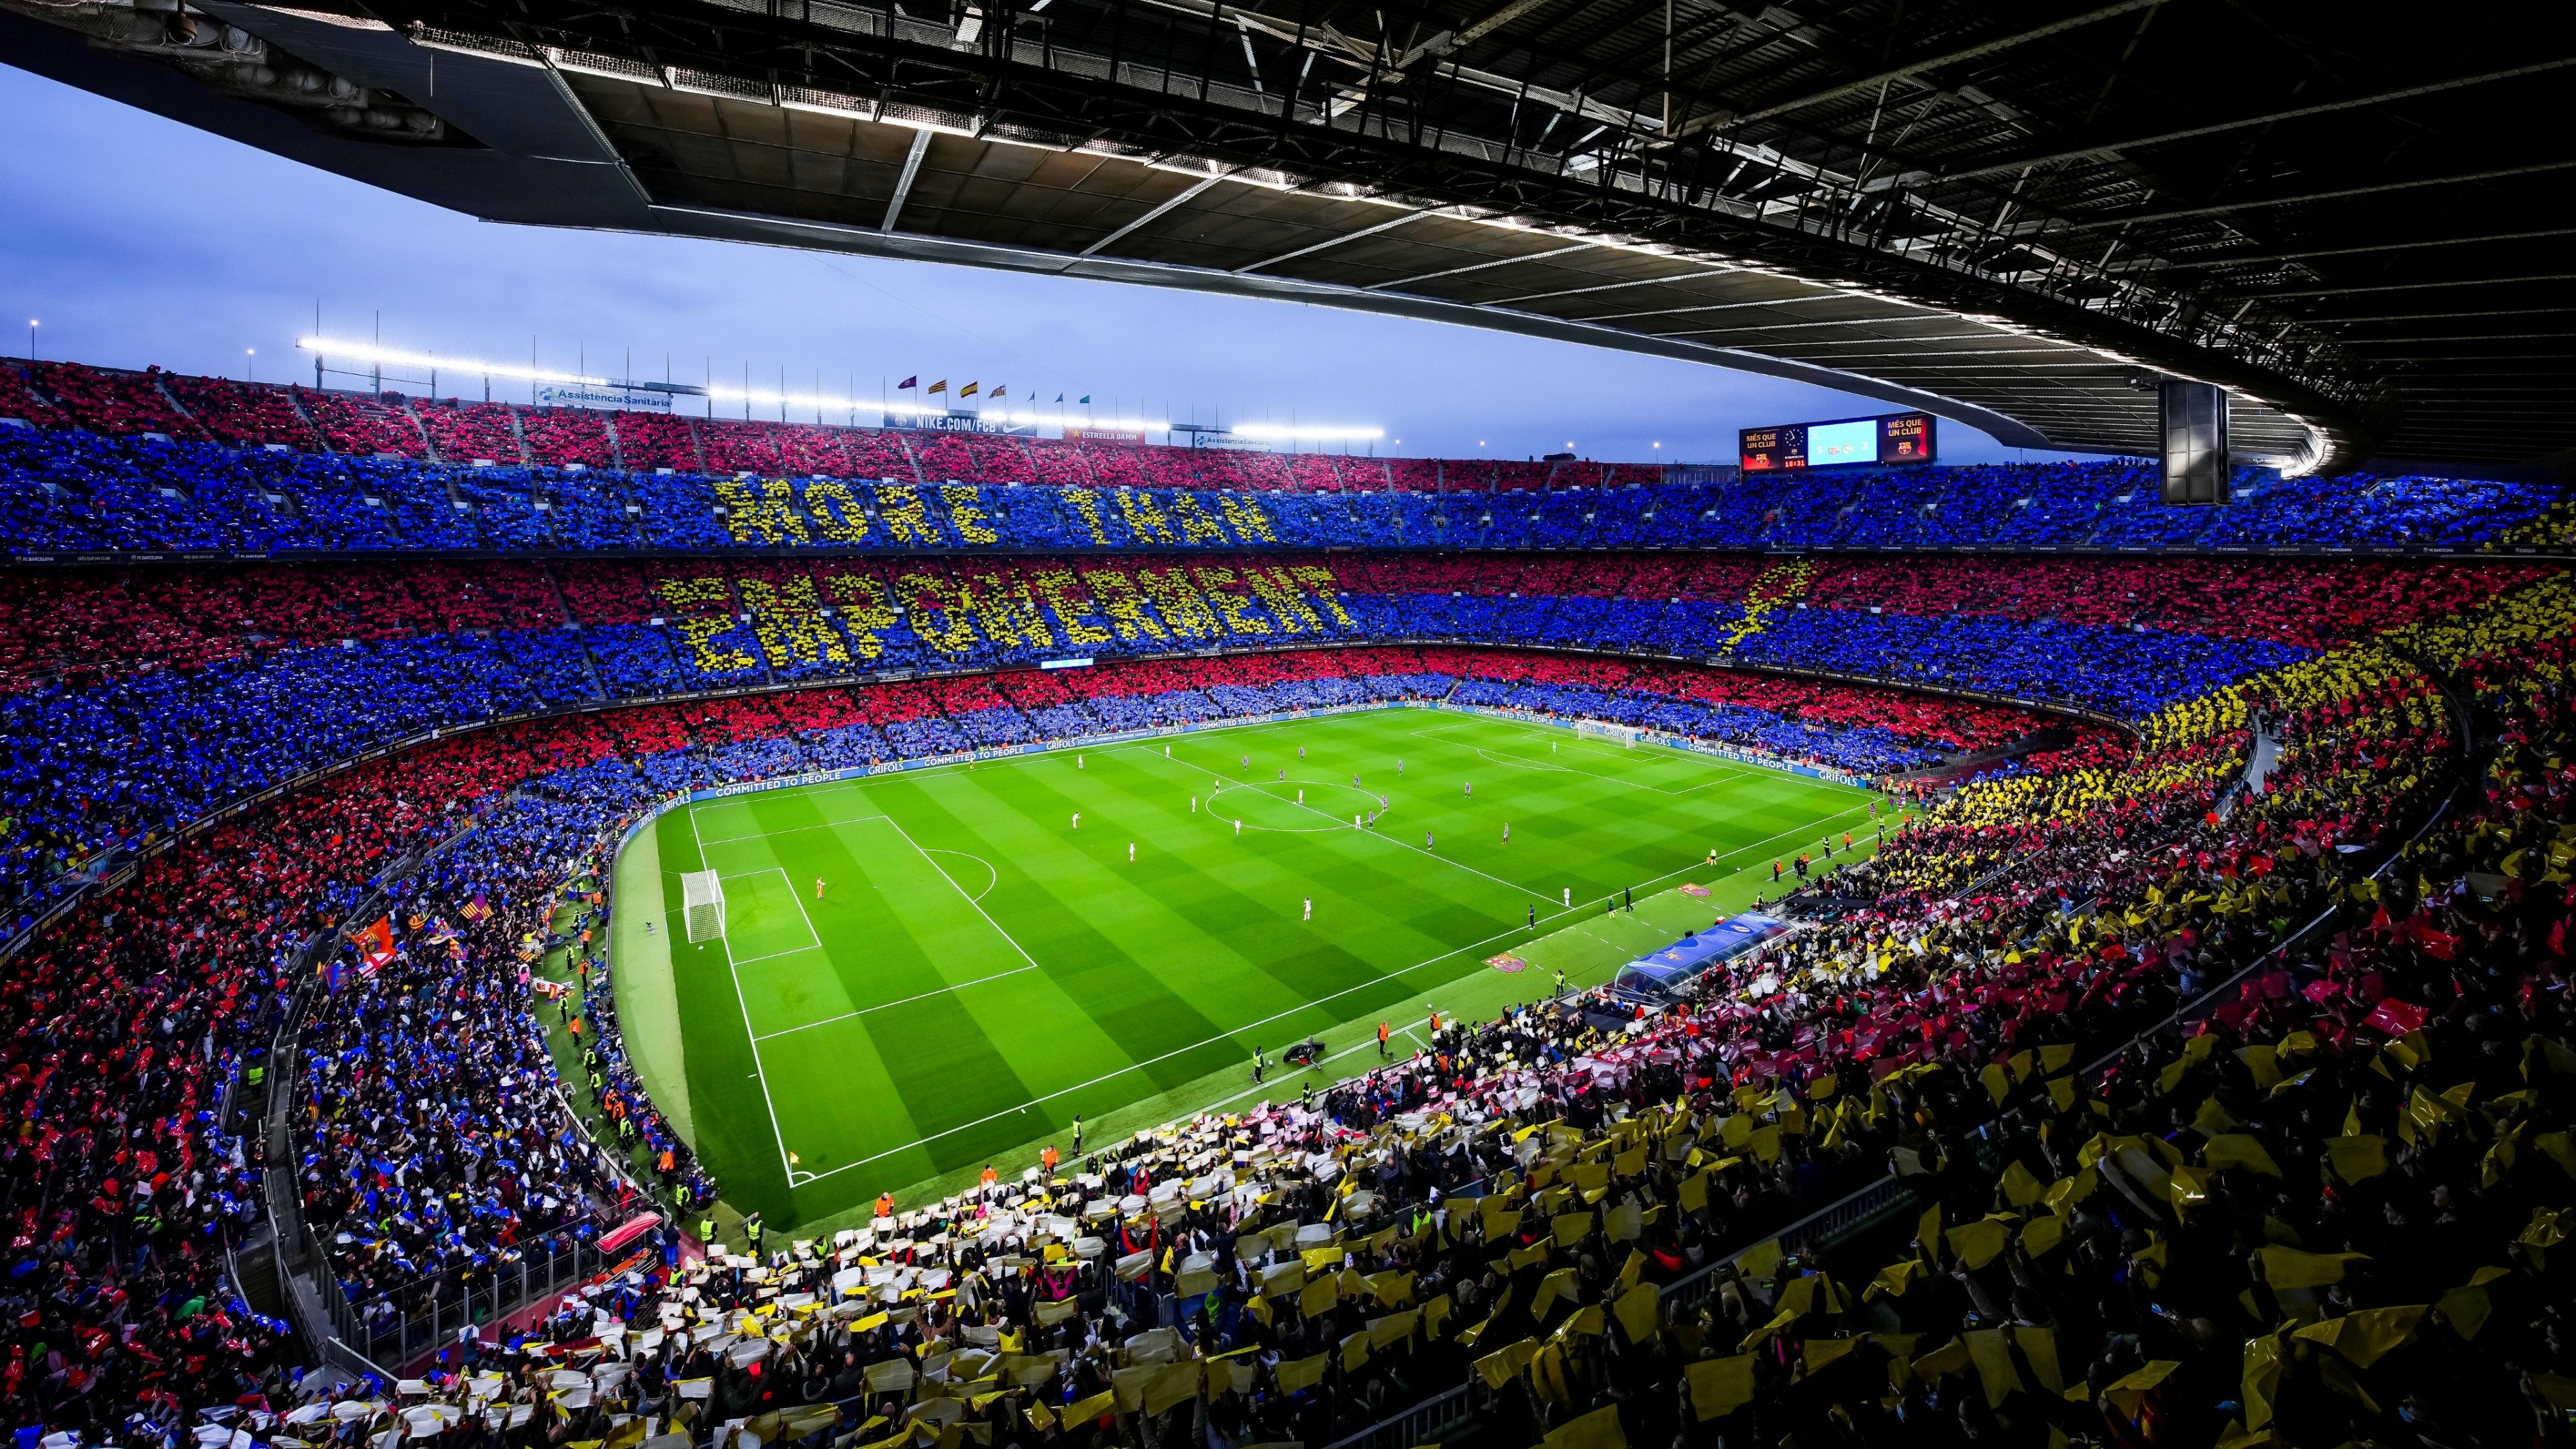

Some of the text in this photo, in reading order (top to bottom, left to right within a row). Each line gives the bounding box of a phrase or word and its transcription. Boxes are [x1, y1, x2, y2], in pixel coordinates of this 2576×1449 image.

[558, 390, 670, 408] Assistència Sanitària
[916, 416, 996, 433] NIKE.COM/FCB
[1888, 419, 1922, 429] MÉS QUE
[1901, 427, 1921, 435] CLUB
[1082, 431, 1137, 441] ESTRELLA DAMM
[1746, 434, 1761, 442] MÉS
[714, 478, 1275, 545] MORE THAN
[661, 566, 1352, 671] EMPOWERMENT
[1289, 710, 1311, 719] GRIFOLS
[1324, 706, 1356, 715] COMMITTED
[1367, 702, 1389, 711] PEOPLE
[1437, 703, 1462, 712] GRIFOLS
[1198, 719, 1236, 730] COMMITTED
[1249, 715, 1273, 724] PEOPLE
[1475, 708, 1514, 718] COMMITTED
[1527, 716, 1554, 725] PEOPLE
[1159, 726, 1183, 736] GRIFOLS
[1570, 722, 1597, 733] GRIFOLS
[1046, 739, 1075, 750] GRIFOLS
[1640, 735, 1671, 747] GRIFOLS
[924, 747, 1025, 767] COMMITTED TO PEOPLE
[1688, 743, 1793, 772] COMMITTED TO PEOPLE
[868, 763, 904, 775] GRIFOLS
[716, 772, 841, 797] COMMITTED TO PEOPLE
[1819, 771, 1858, 788] GRIFOLS
[662, 794, 691, 812] GRIFOLS
[638, 808, 657, 829] GRIFOLS
